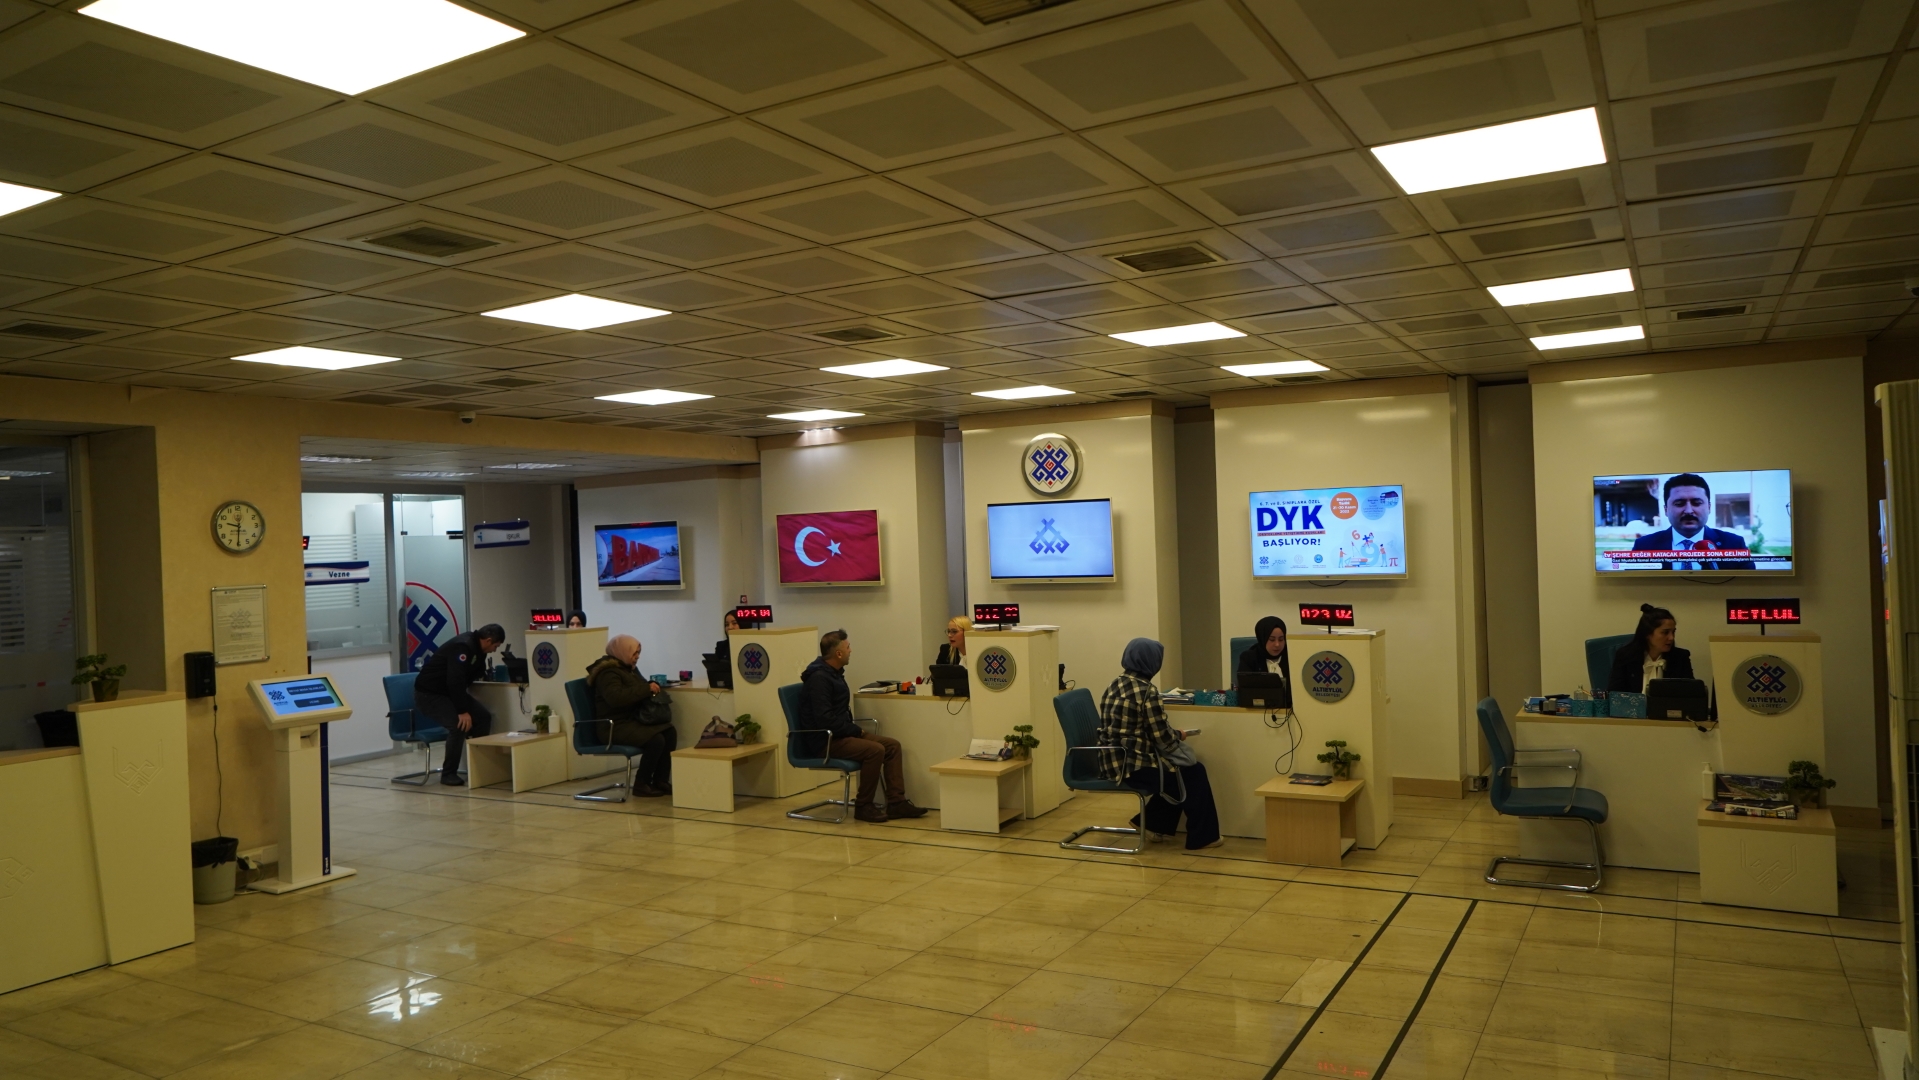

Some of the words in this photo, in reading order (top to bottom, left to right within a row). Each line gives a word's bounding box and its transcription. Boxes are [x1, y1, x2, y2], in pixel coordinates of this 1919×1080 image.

[1256, 505, 1325, 531] DYK
[1351, 529, 1361, 540] 6
[1262, 538, 1321, 547] BAŞLIYOR!
